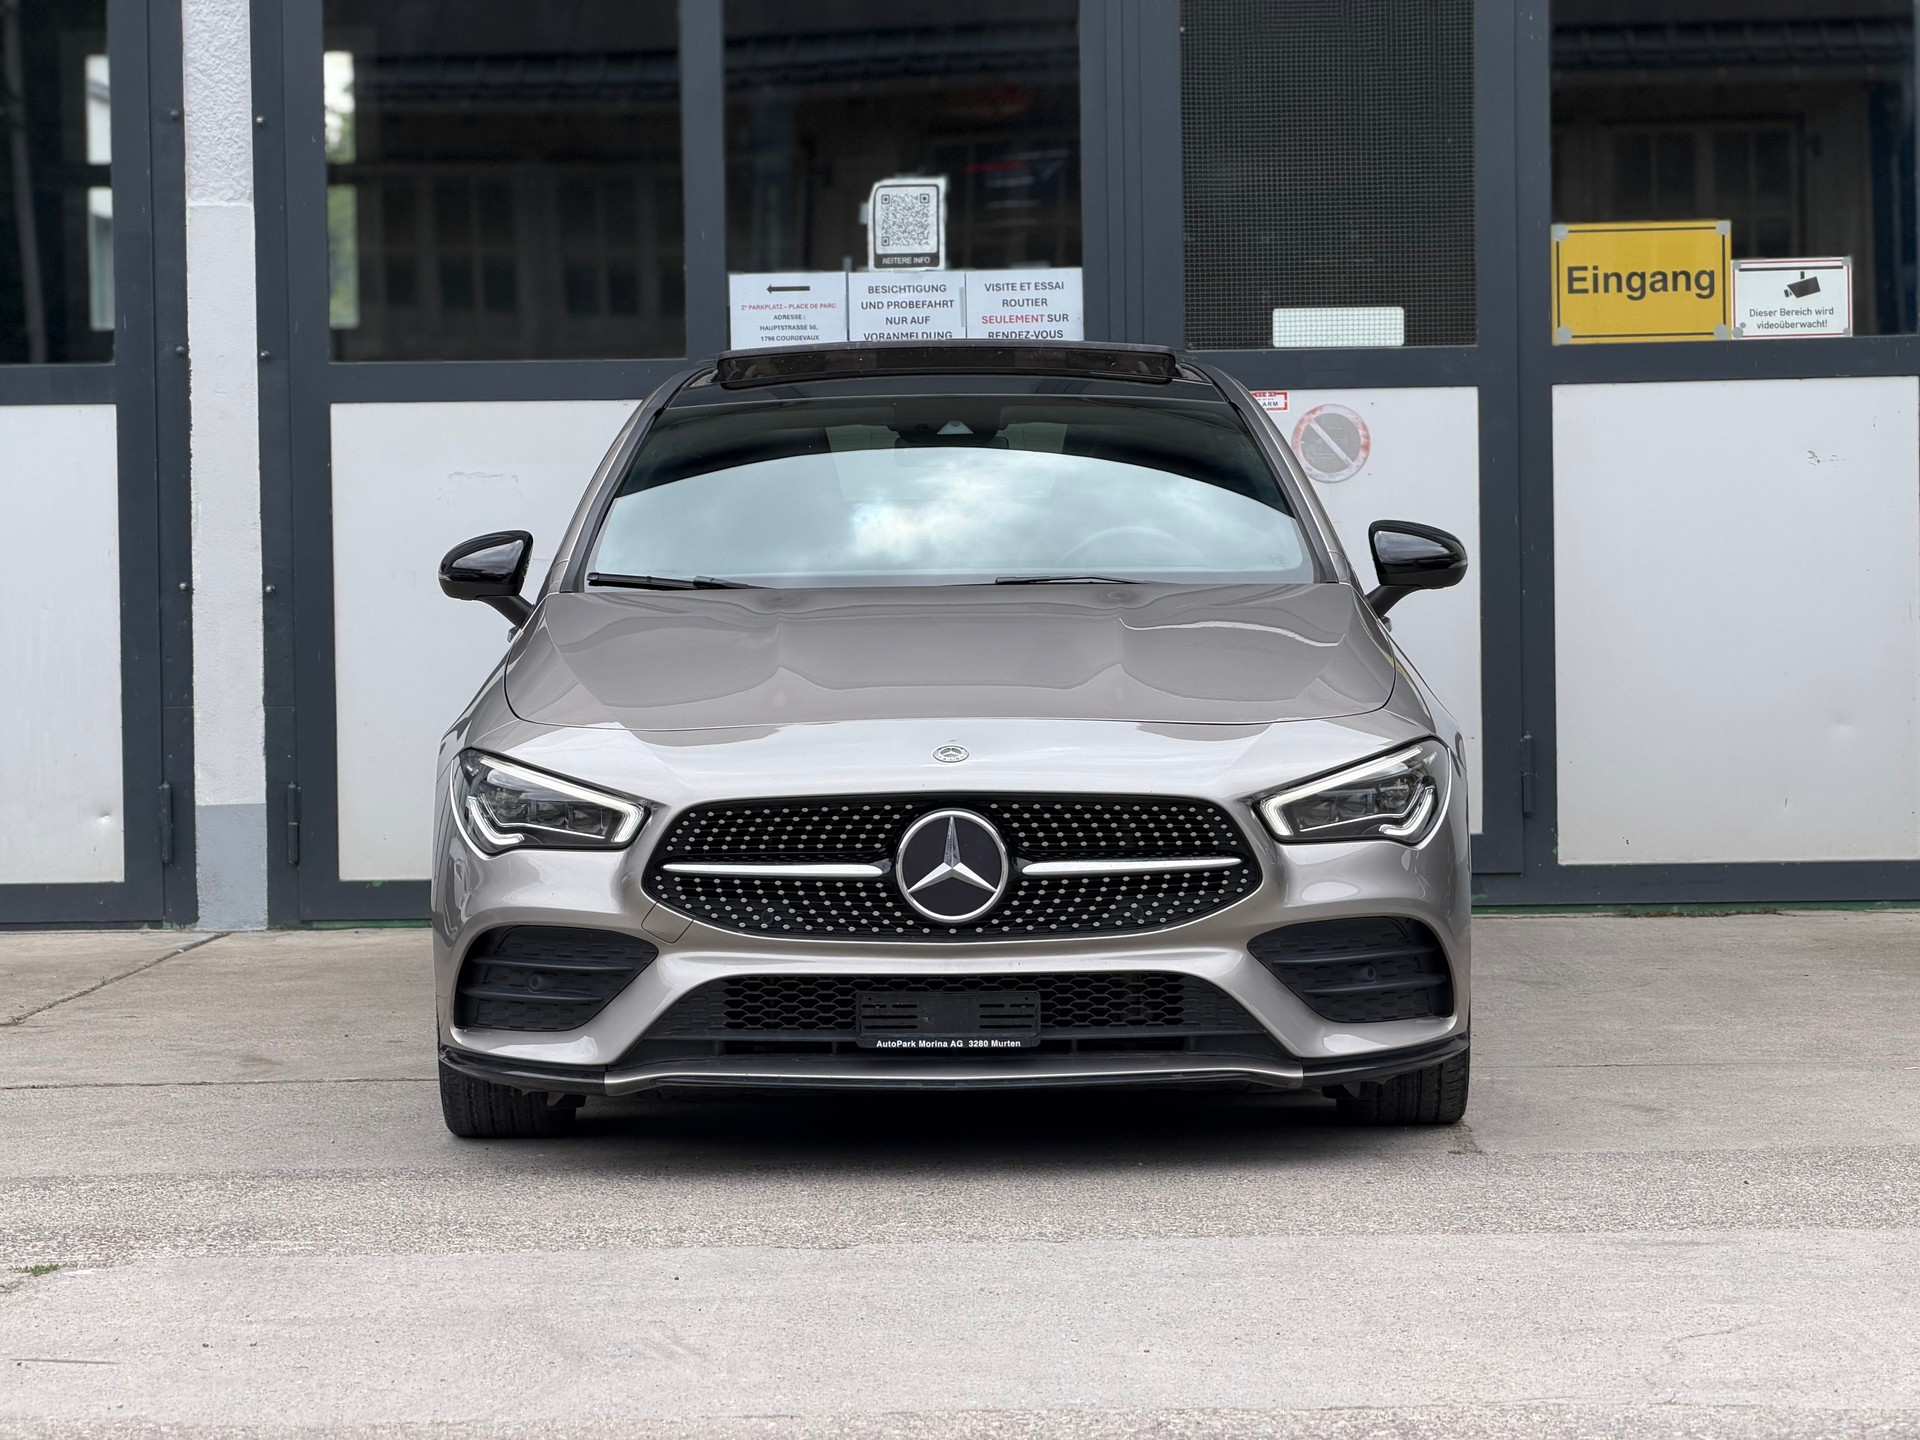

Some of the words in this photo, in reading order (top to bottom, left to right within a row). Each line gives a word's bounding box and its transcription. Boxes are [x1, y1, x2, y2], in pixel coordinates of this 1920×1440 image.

[913, 256, 931, 264] INFO
[984, 283, 1017, 292] VISITE
[1020, 282, 1032, 291] ET
[1034, 281, 1064, 290] ESSAI
[1567, 265, 1716, 301] Eingang
[868, 284, 947, 294] BESICHTIGUNG
[861, 301, 884, 310] UND
[887, 300, 954, 309] PROBEFAHRT
[1002, 298, 1048, 307] ROUTIER
[1749, 308, 1778, 317] Dieser
[1780, 307, 1813, 317] Bereich
[1815, 306, 1834, 316] wird
[885, 316, 908, 325] NUR
[910, 316, 931, 325] AUF
[981, 314, 1044, 324] SEULEMENT
[1047, 313, 1069, 322] SUR
[1756, 319, 1828, 330] videoüberwacht!
[863, 331, 953, 341] VORANMELDUNG
[988, 330, 1063, 339] RENDEZ-VOUS
[876, 1040, 916, 1048] AutoPark
[918, 1039, 948, 1048] Morina
[950, 1040, 963, 1048] AG
[968, 1039, 989, 1048] 3280
[991, 1039, 1021, 1048] Murten
